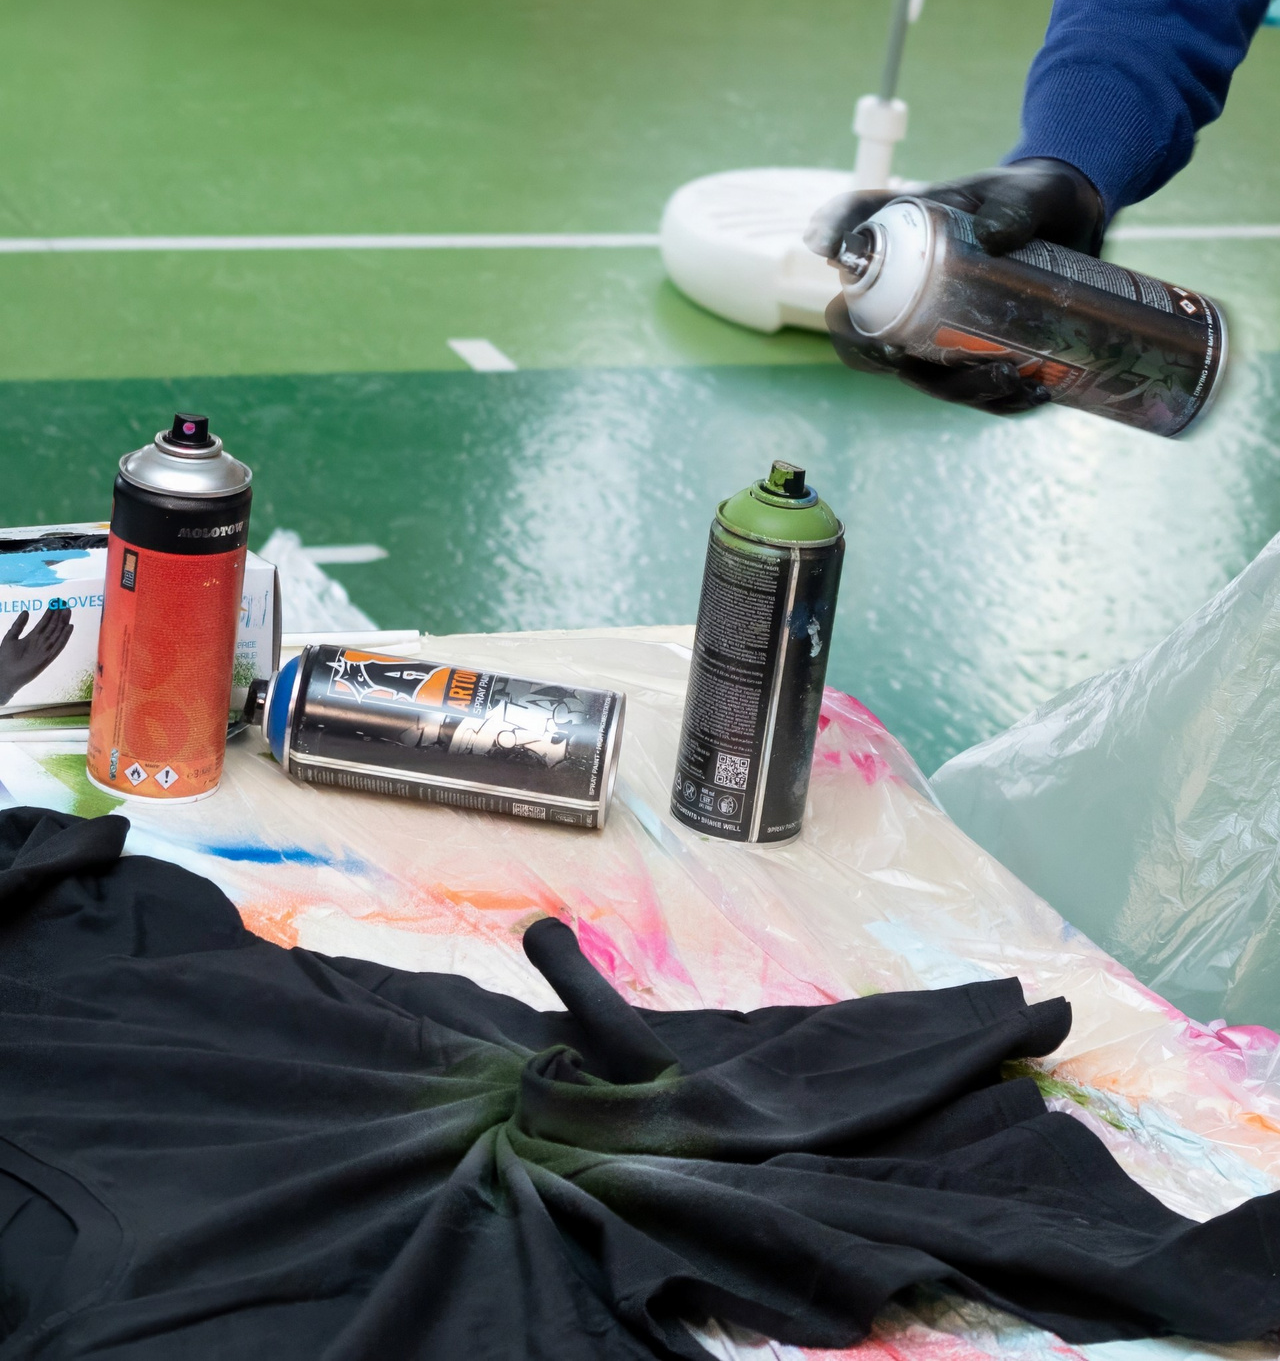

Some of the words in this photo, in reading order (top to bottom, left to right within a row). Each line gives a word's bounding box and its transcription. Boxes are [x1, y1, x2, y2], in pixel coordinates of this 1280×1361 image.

[178, 521, 244, 538] MOLOTOW
[49, 595, 104, 610] GLOVES
[473, 686, 486, 715] SPRAY
